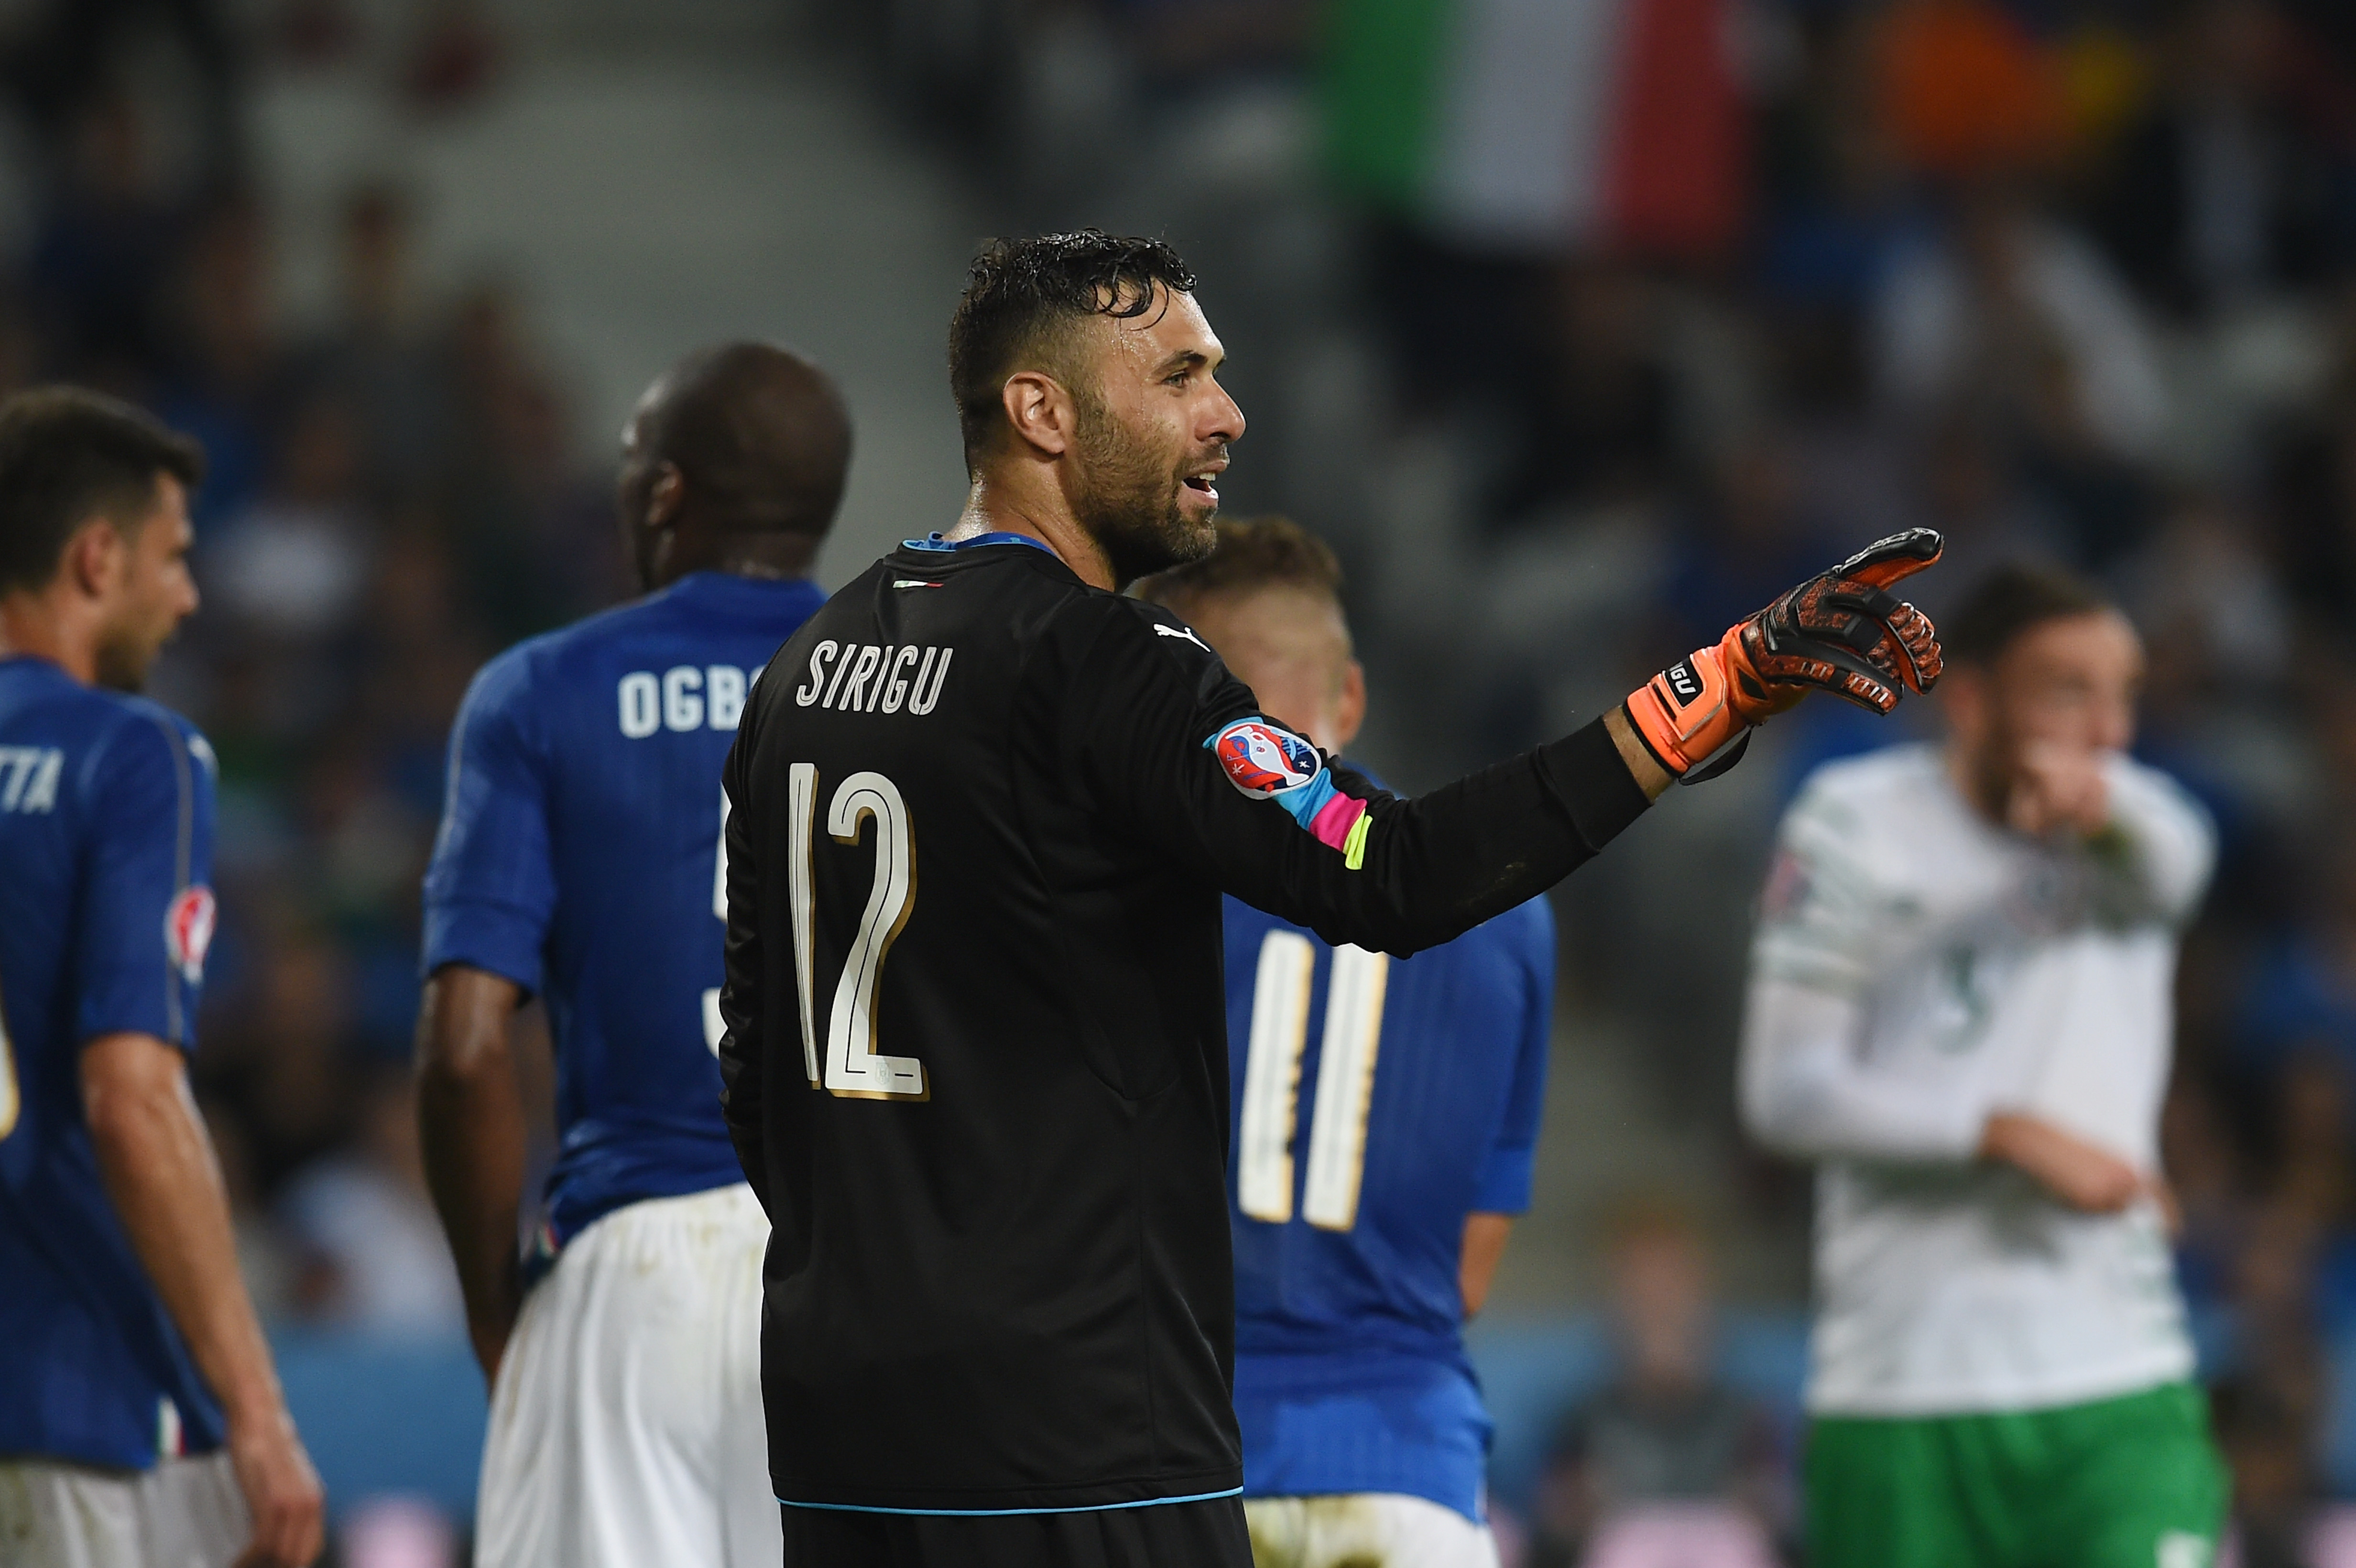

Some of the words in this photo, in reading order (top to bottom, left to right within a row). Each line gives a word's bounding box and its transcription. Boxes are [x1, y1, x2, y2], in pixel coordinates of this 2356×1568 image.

[618, 664, 767, 739] OGB
[796, 640, 953, 715] SIRIGU
[1669, 661, 1697, 694] IGU
[788, 762, 930, 1102] 12
[1238, 928, 1389, 1232] 11
